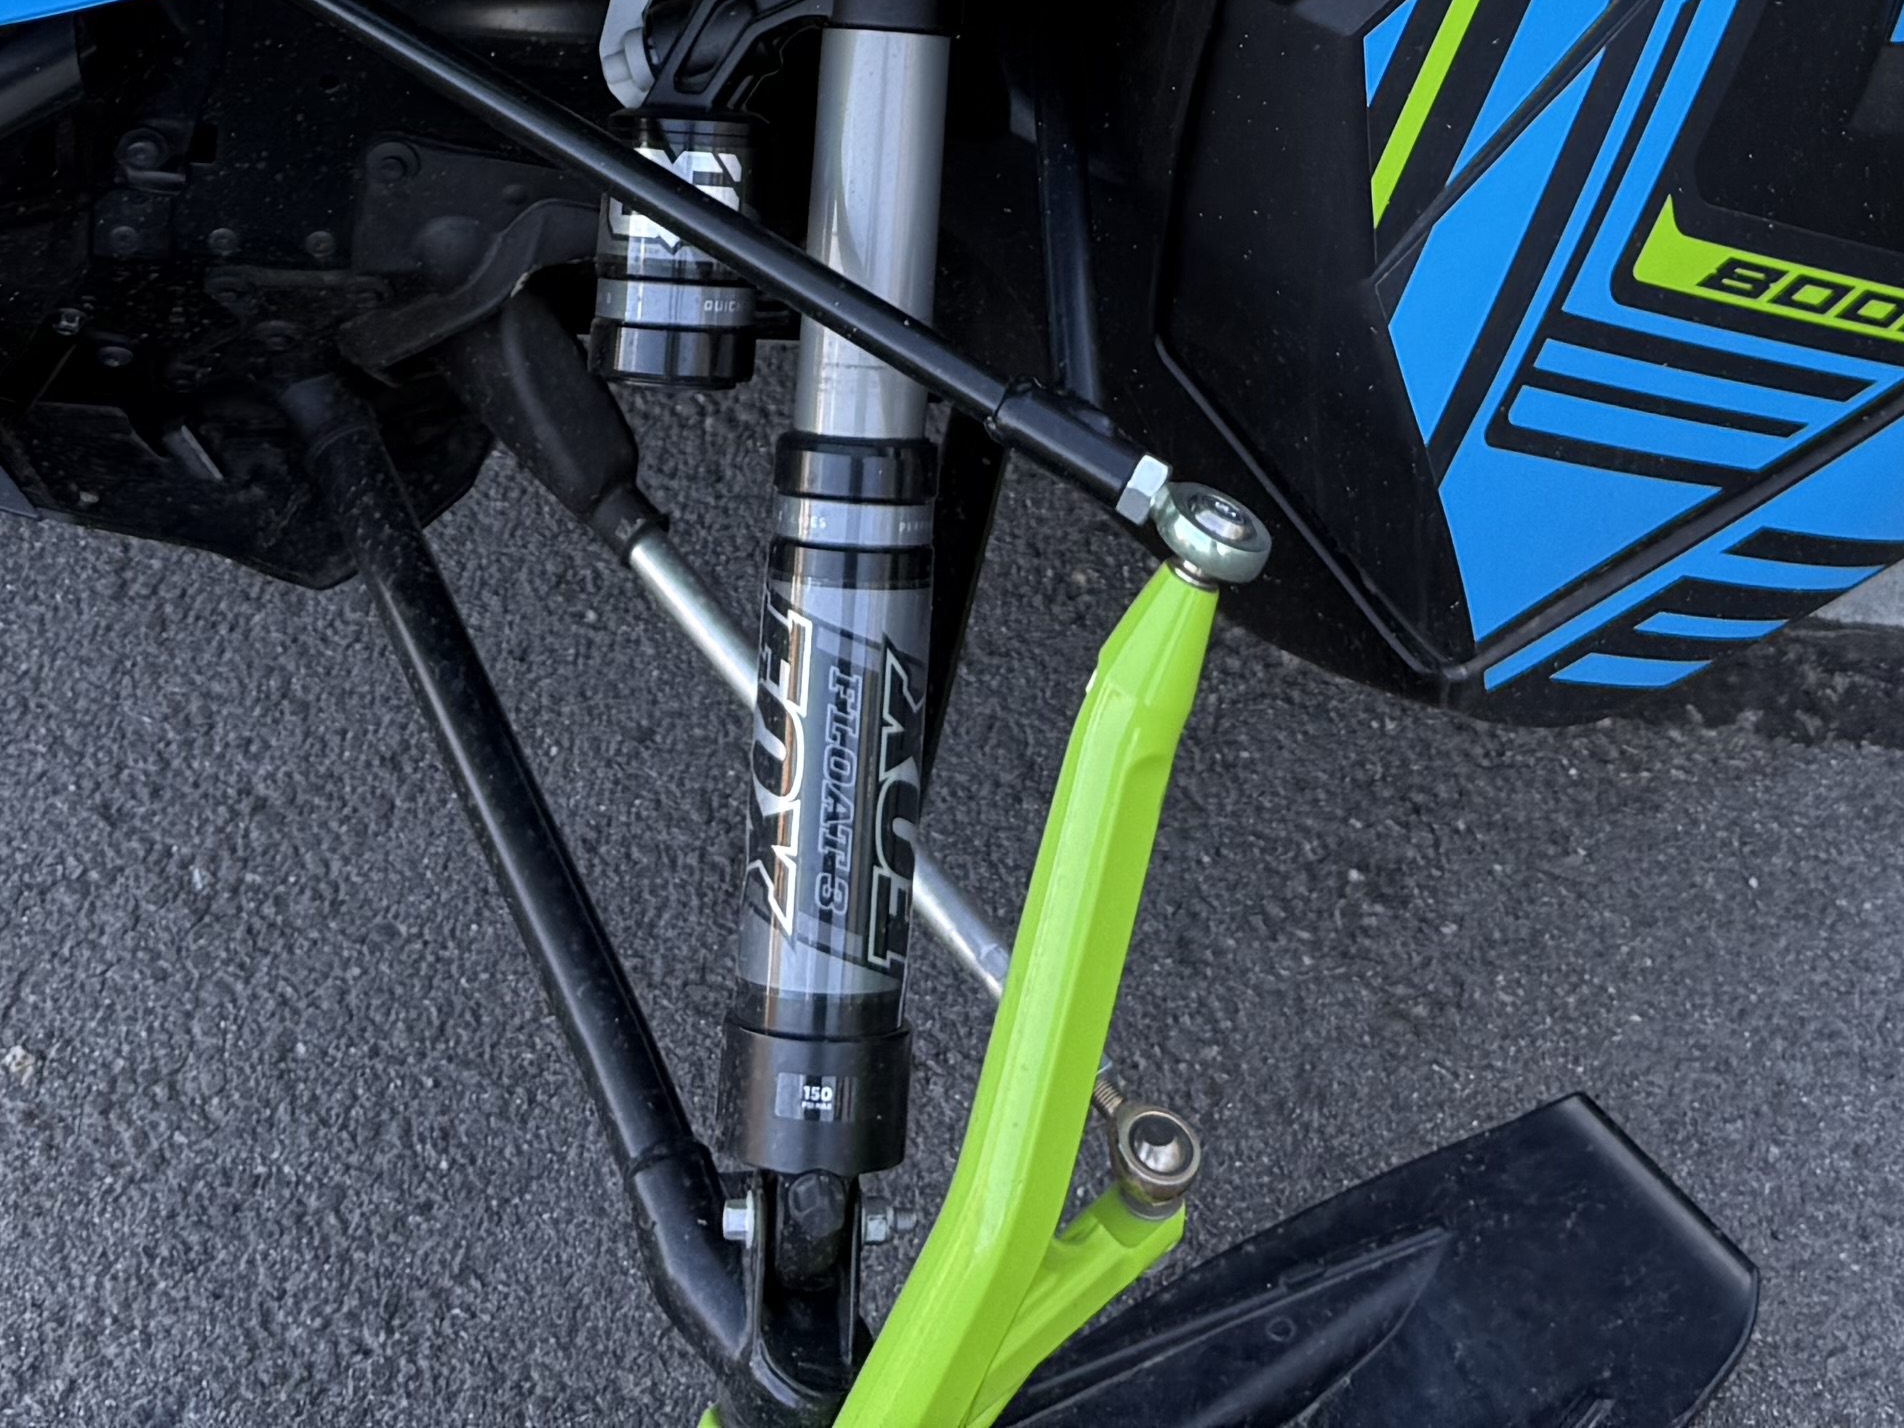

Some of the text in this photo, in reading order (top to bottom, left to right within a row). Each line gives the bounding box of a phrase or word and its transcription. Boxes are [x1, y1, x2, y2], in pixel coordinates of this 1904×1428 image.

[748, 589, 814, 937] FOX
[814, 664, 864, 916] FLOAT 3
[803, 1085, 834, 1102] 150
